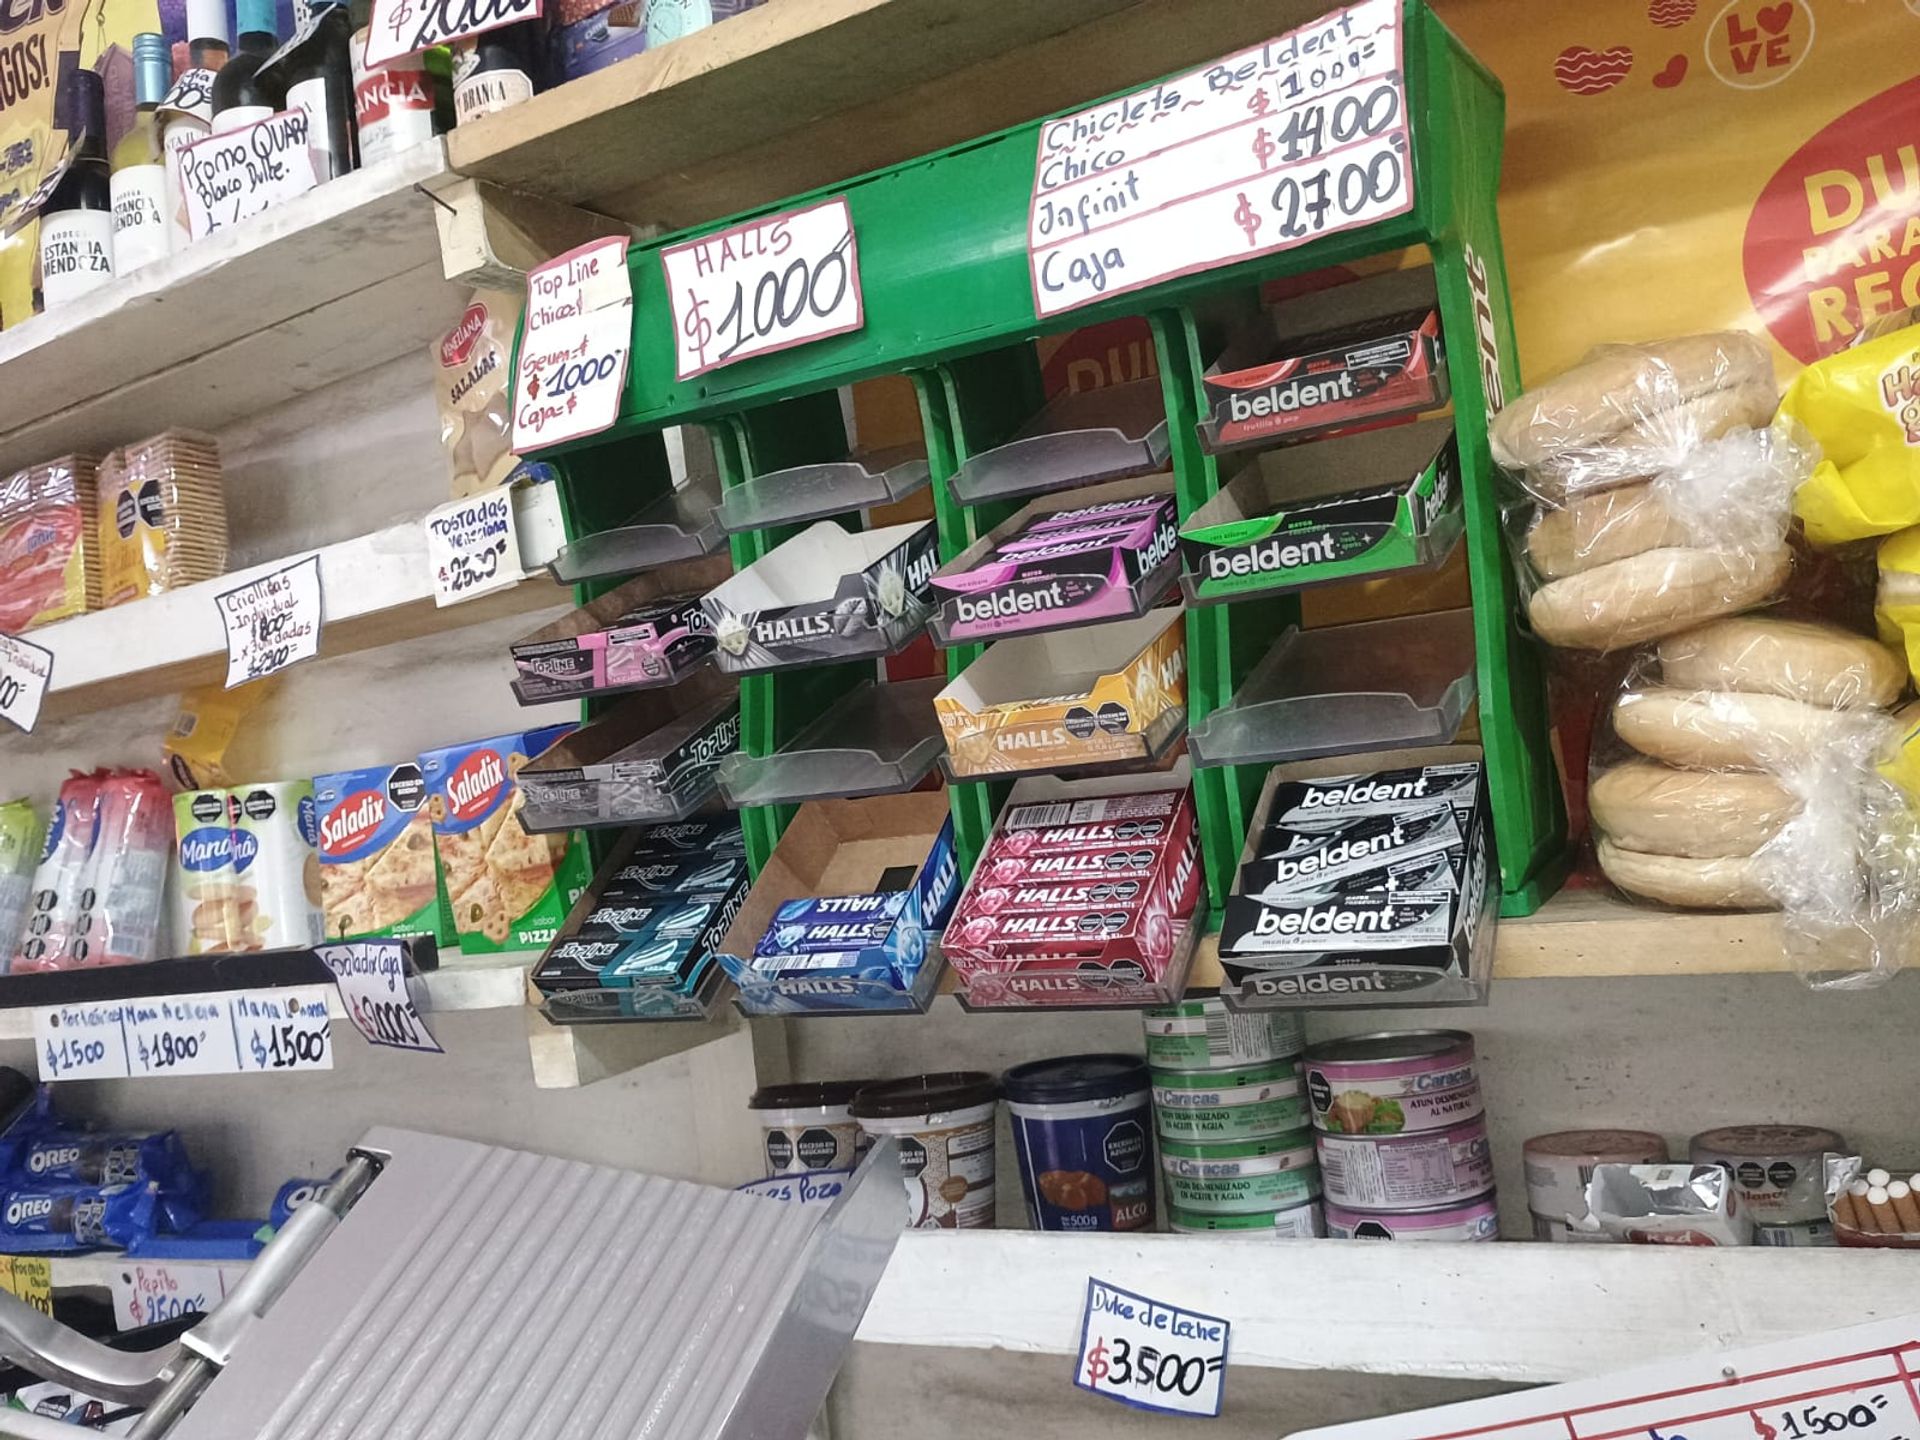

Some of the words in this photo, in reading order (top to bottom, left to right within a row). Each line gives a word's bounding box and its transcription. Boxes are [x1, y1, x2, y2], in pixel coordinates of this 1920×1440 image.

[0, 33, 50, 111] GOS!
[1045, 85, 1183, 151] Chiclets
[1203, 10, 1354, 93] Beldent
[1041, 148, 1126, 190] Chico
[112, 211, 162, 232] ENDOA
[44, 239, 104, 261] ESTANIA
[694, 222, 793, 278] HALLS
[1041, 247, 1126, 292] Caja
[533, 275, 563, 299] Top
[567, 257, 600, 287] Line
[1464, 242, 1505, 420] ent
[1230, 370, 1353, 423] beldent
[907, 549, 940, 591] HAL
[1136, 522, 1178, 576] belde
[1209, 532, 1336, 580] beldent
[956, 581, 1065, 623] beldent
[445, 757, 504, 815] Saladix
[1300, 776, 1428, 809] beldent
[319, 795, 385, 851] Saladix
[1276, 824, 1405, 884] beldent
[921, 847, 958, 928] HALL
[1254, 904, 1395, 937] beldent
[1255, 970, 1386, 996] beldent
[30, 1146, 81, 1174] OREO
[6, 1197, 52, 1226] OREO
